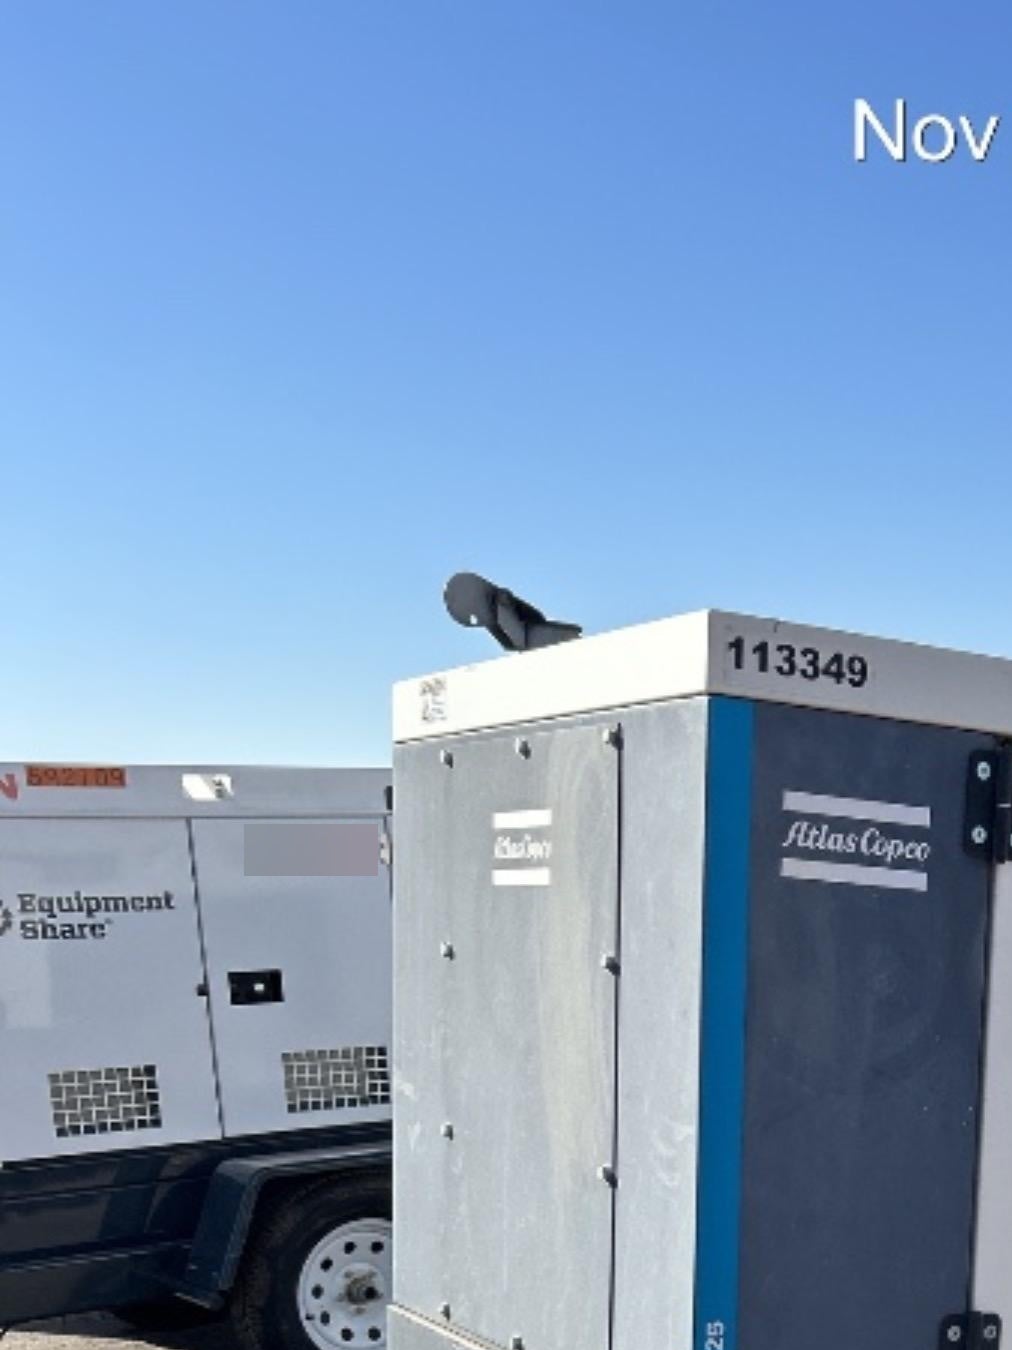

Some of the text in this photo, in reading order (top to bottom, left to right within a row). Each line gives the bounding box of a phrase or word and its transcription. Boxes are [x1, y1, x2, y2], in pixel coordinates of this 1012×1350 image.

[728, 635, 868, 688] 113349
[17, 890, 175, 919] Equipment
[20, 920, 107, 941] Share
